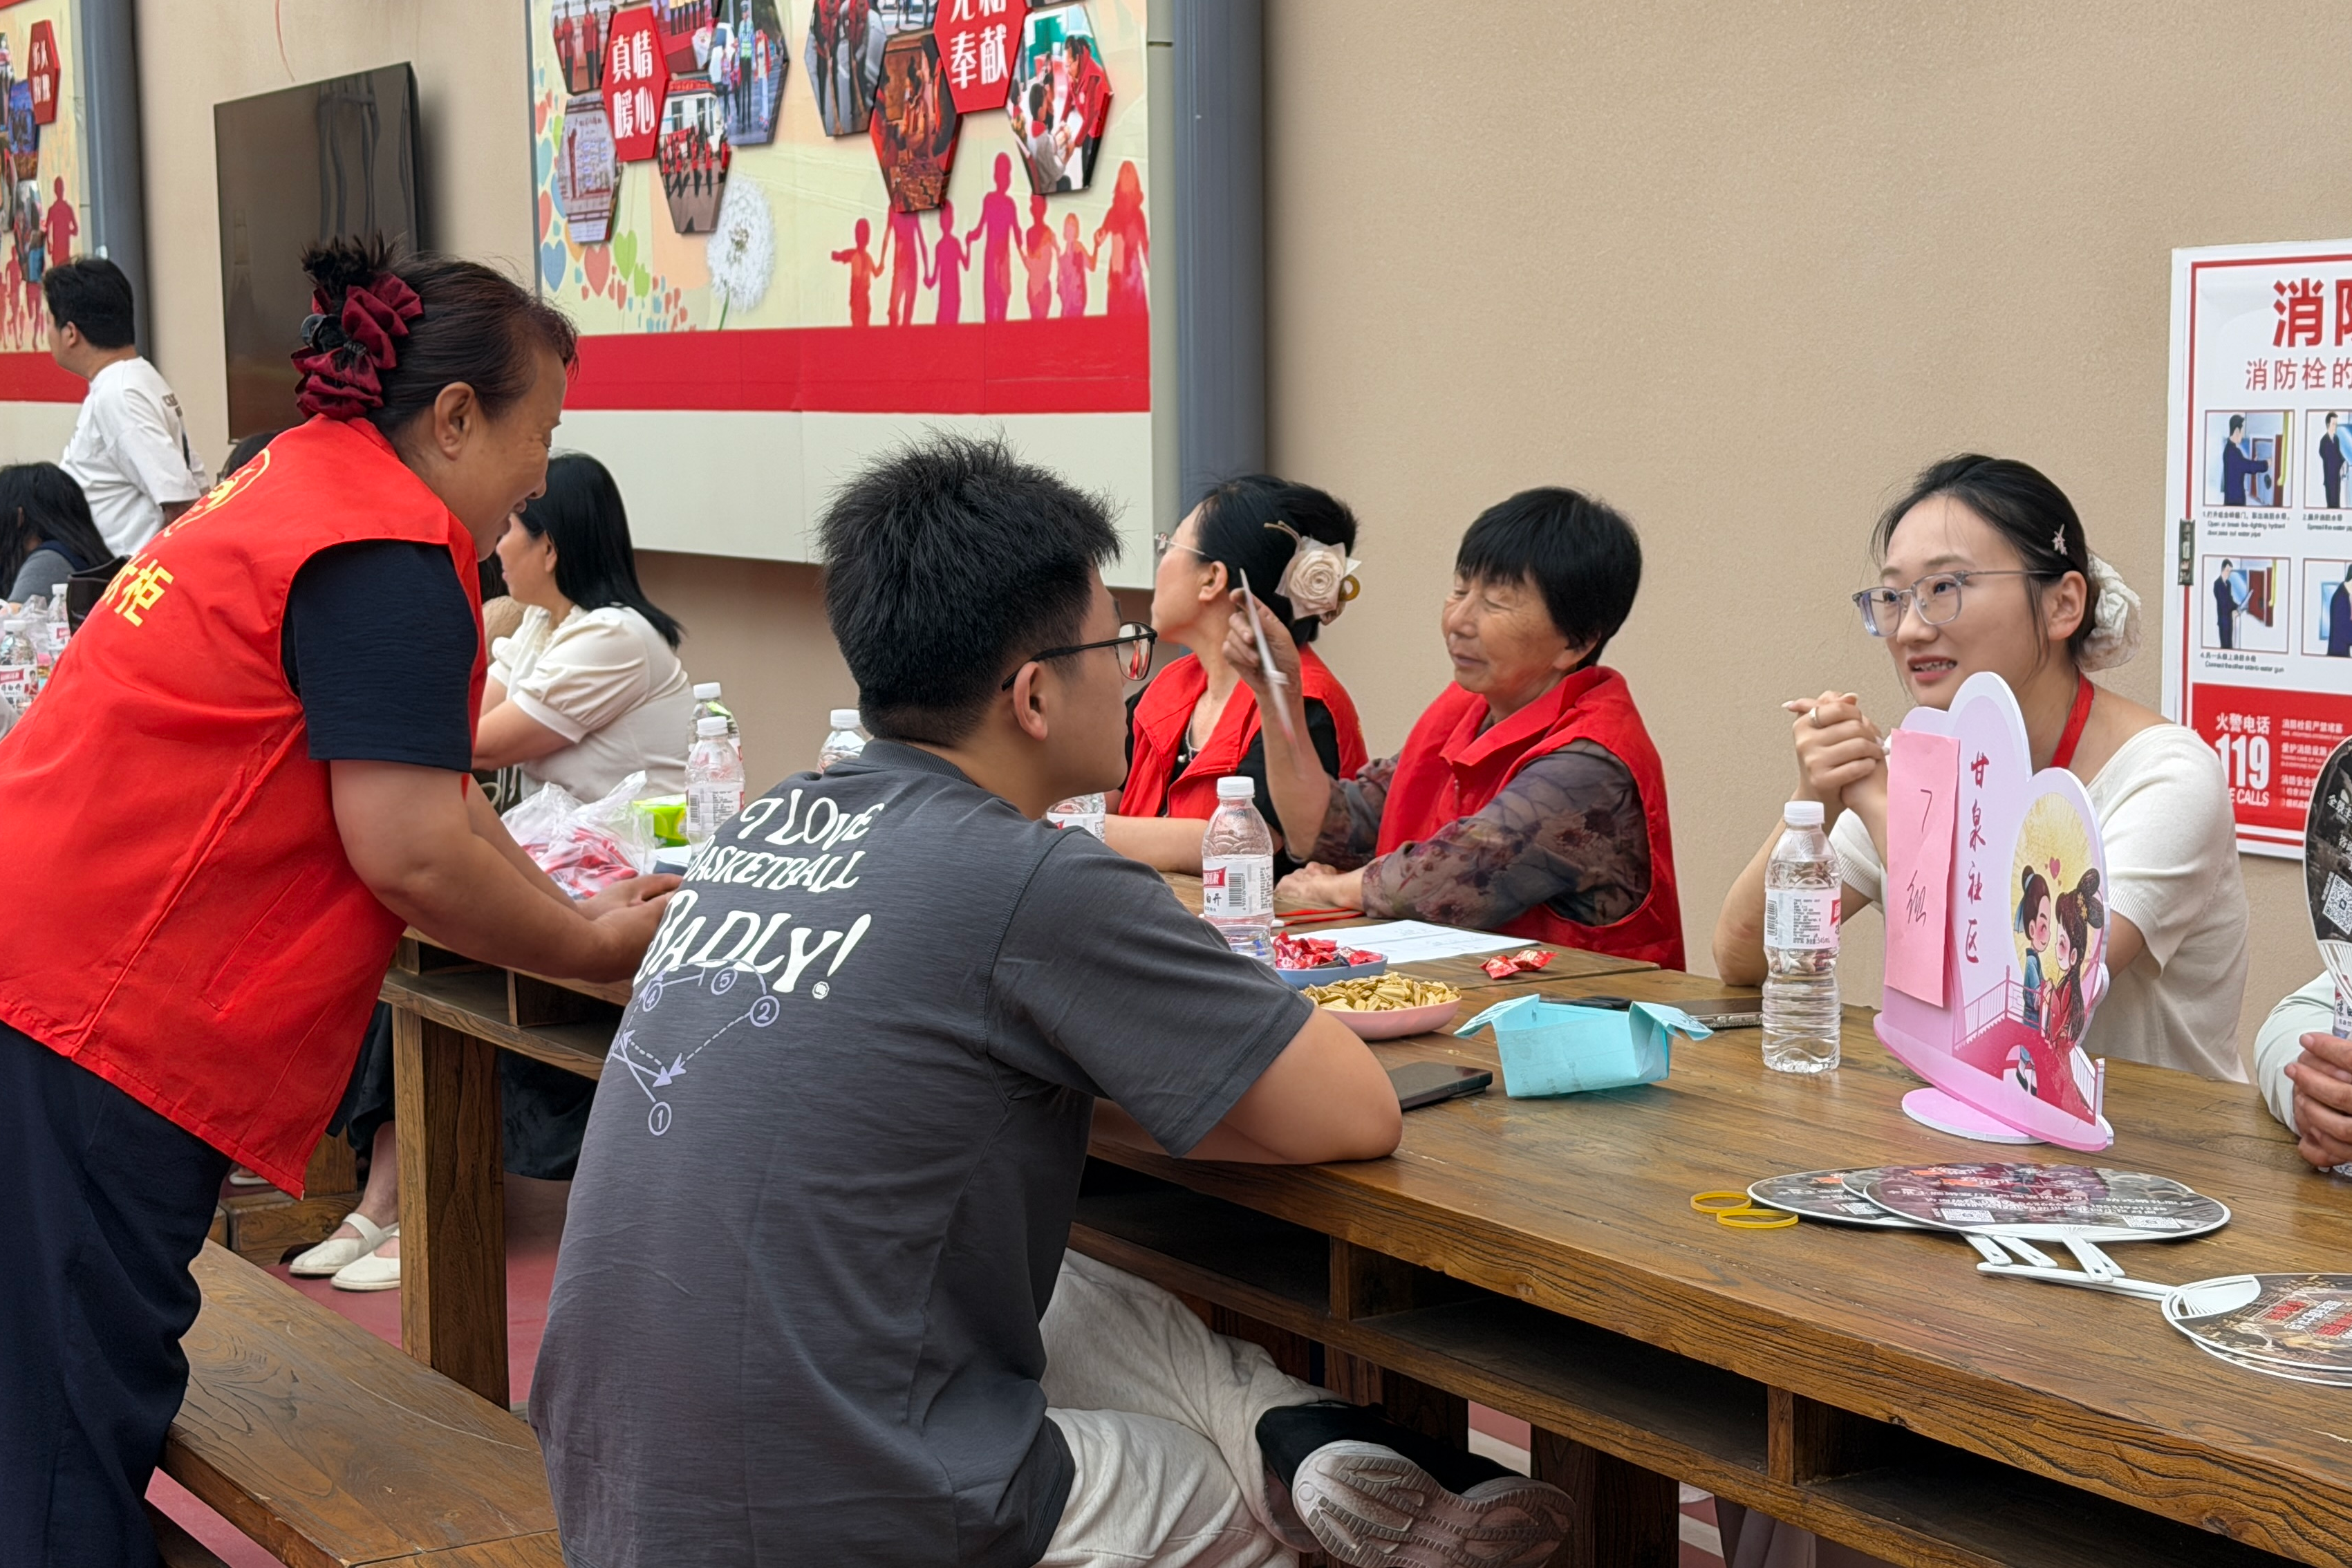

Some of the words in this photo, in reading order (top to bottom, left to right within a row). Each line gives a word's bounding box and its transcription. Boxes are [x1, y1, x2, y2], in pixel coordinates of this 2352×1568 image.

[612, 29, 653, 84] 真情
[950, 24, 1009, 89] 奉献
[613, 86, 655, 139] 暖心
[2246, 357, 2352, 391] 消防栓的
[2215, 712, 2270, 735] 火警电话
[2215, 733, 2270, 790] 119
[765, 788, 885, 850] LOVE
[2237, 788, 2270, 807] CALLS
[682, 834, 866, 893] BASKETBALL
[1966, 751, 1989, 963] 甘泉社区
[633, 889, 872, 1000] BADLY!
